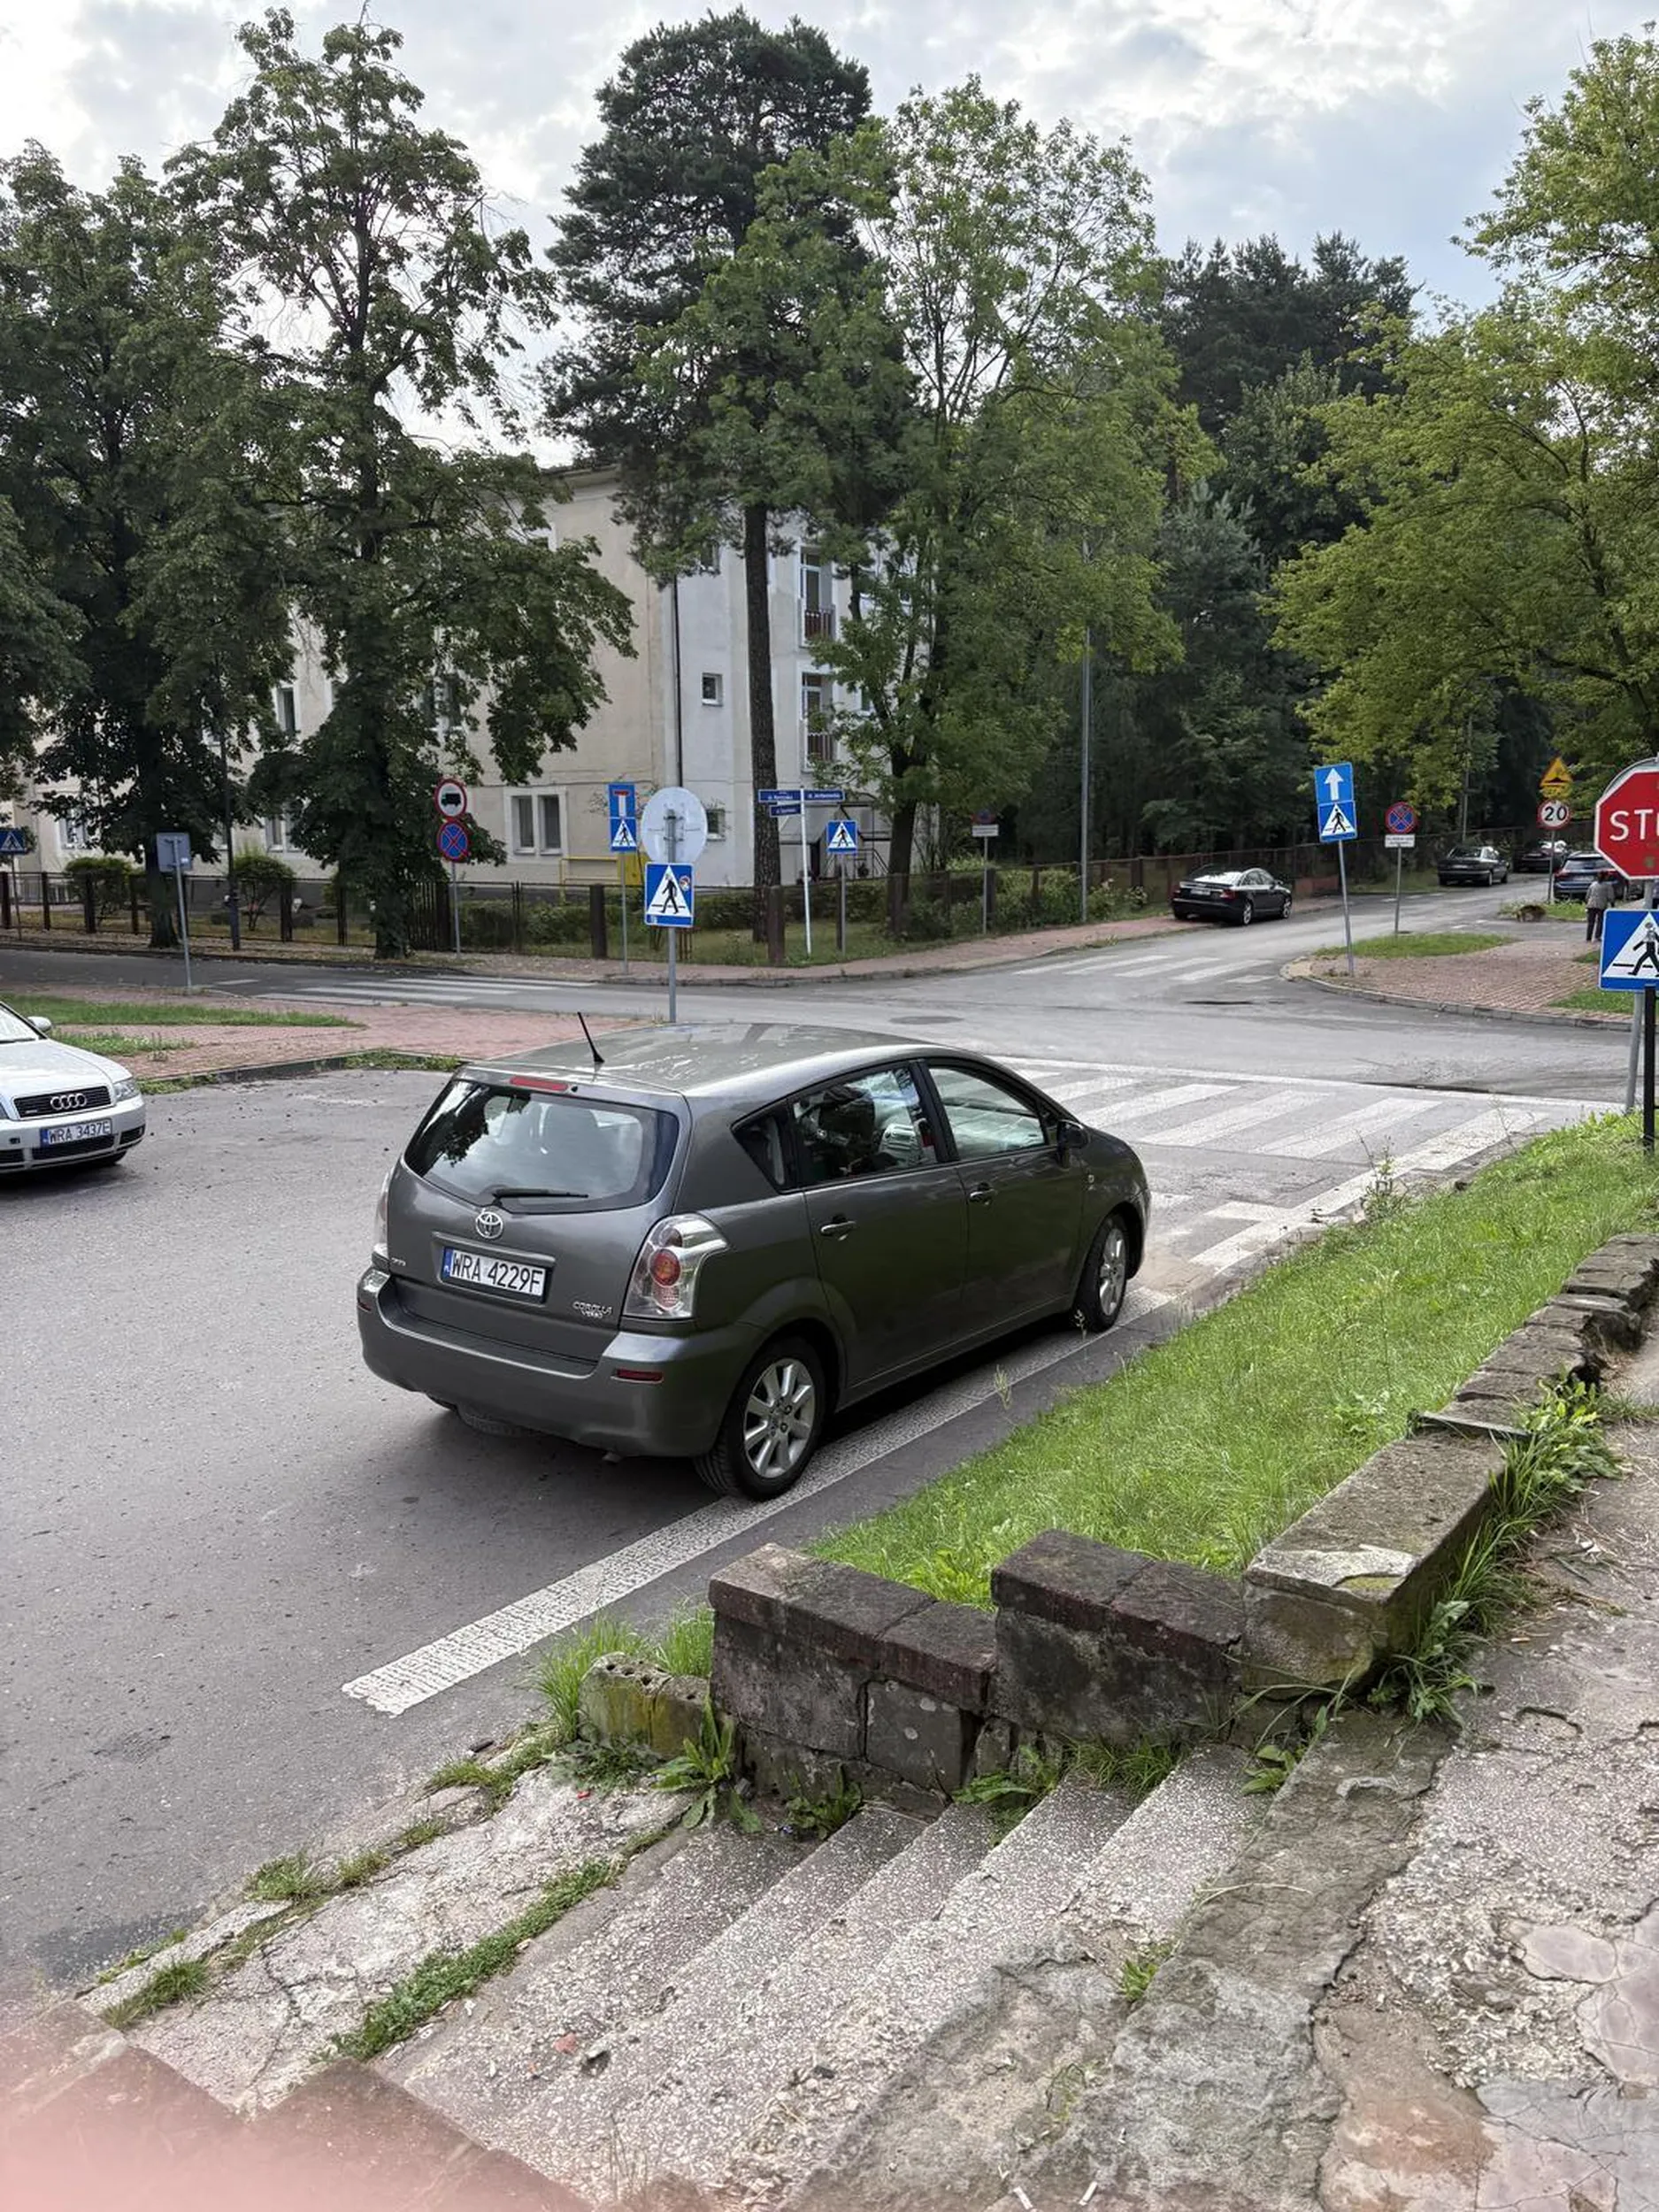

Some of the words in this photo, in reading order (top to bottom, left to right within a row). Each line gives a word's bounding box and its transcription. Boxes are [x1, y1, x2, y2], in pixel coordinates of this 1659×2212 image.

[1544, 805, 1568, 822] 20
[1609, 808, 1659, 841] ST
[49, 1126, 73, 1143] WRA
[451, 1252, 481, 1282] WRA
[488, 1261, 543, 1293] 4229F
